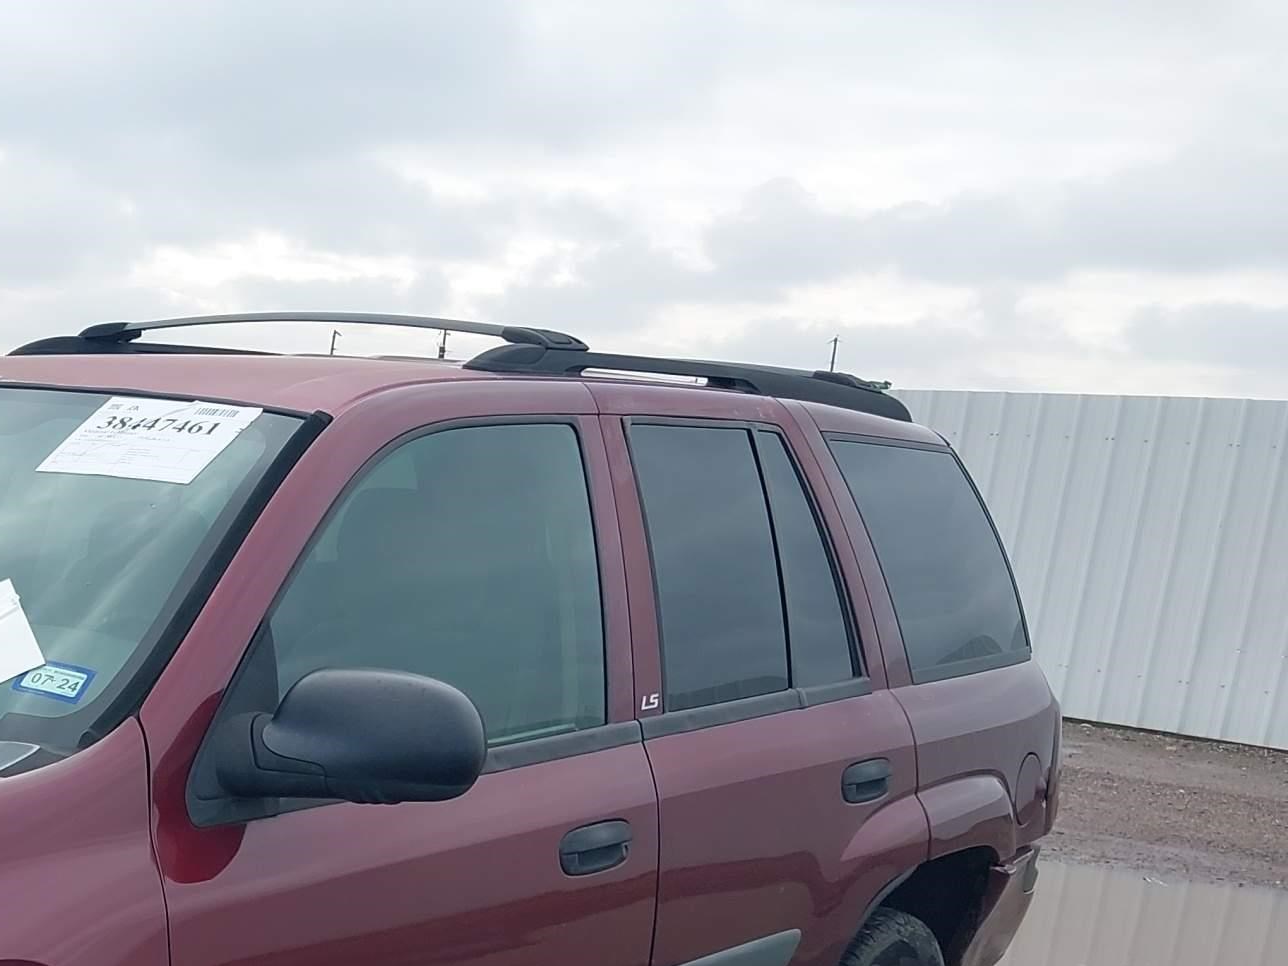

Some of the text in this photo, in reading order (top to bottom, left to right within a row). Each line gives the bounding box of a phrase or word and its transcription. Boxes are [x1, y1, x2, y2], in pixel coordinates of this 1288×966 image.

[31, 672, 54, 686] 07
[56, 678, 80, 693] 24
[641, 693, 659, 710] LS
